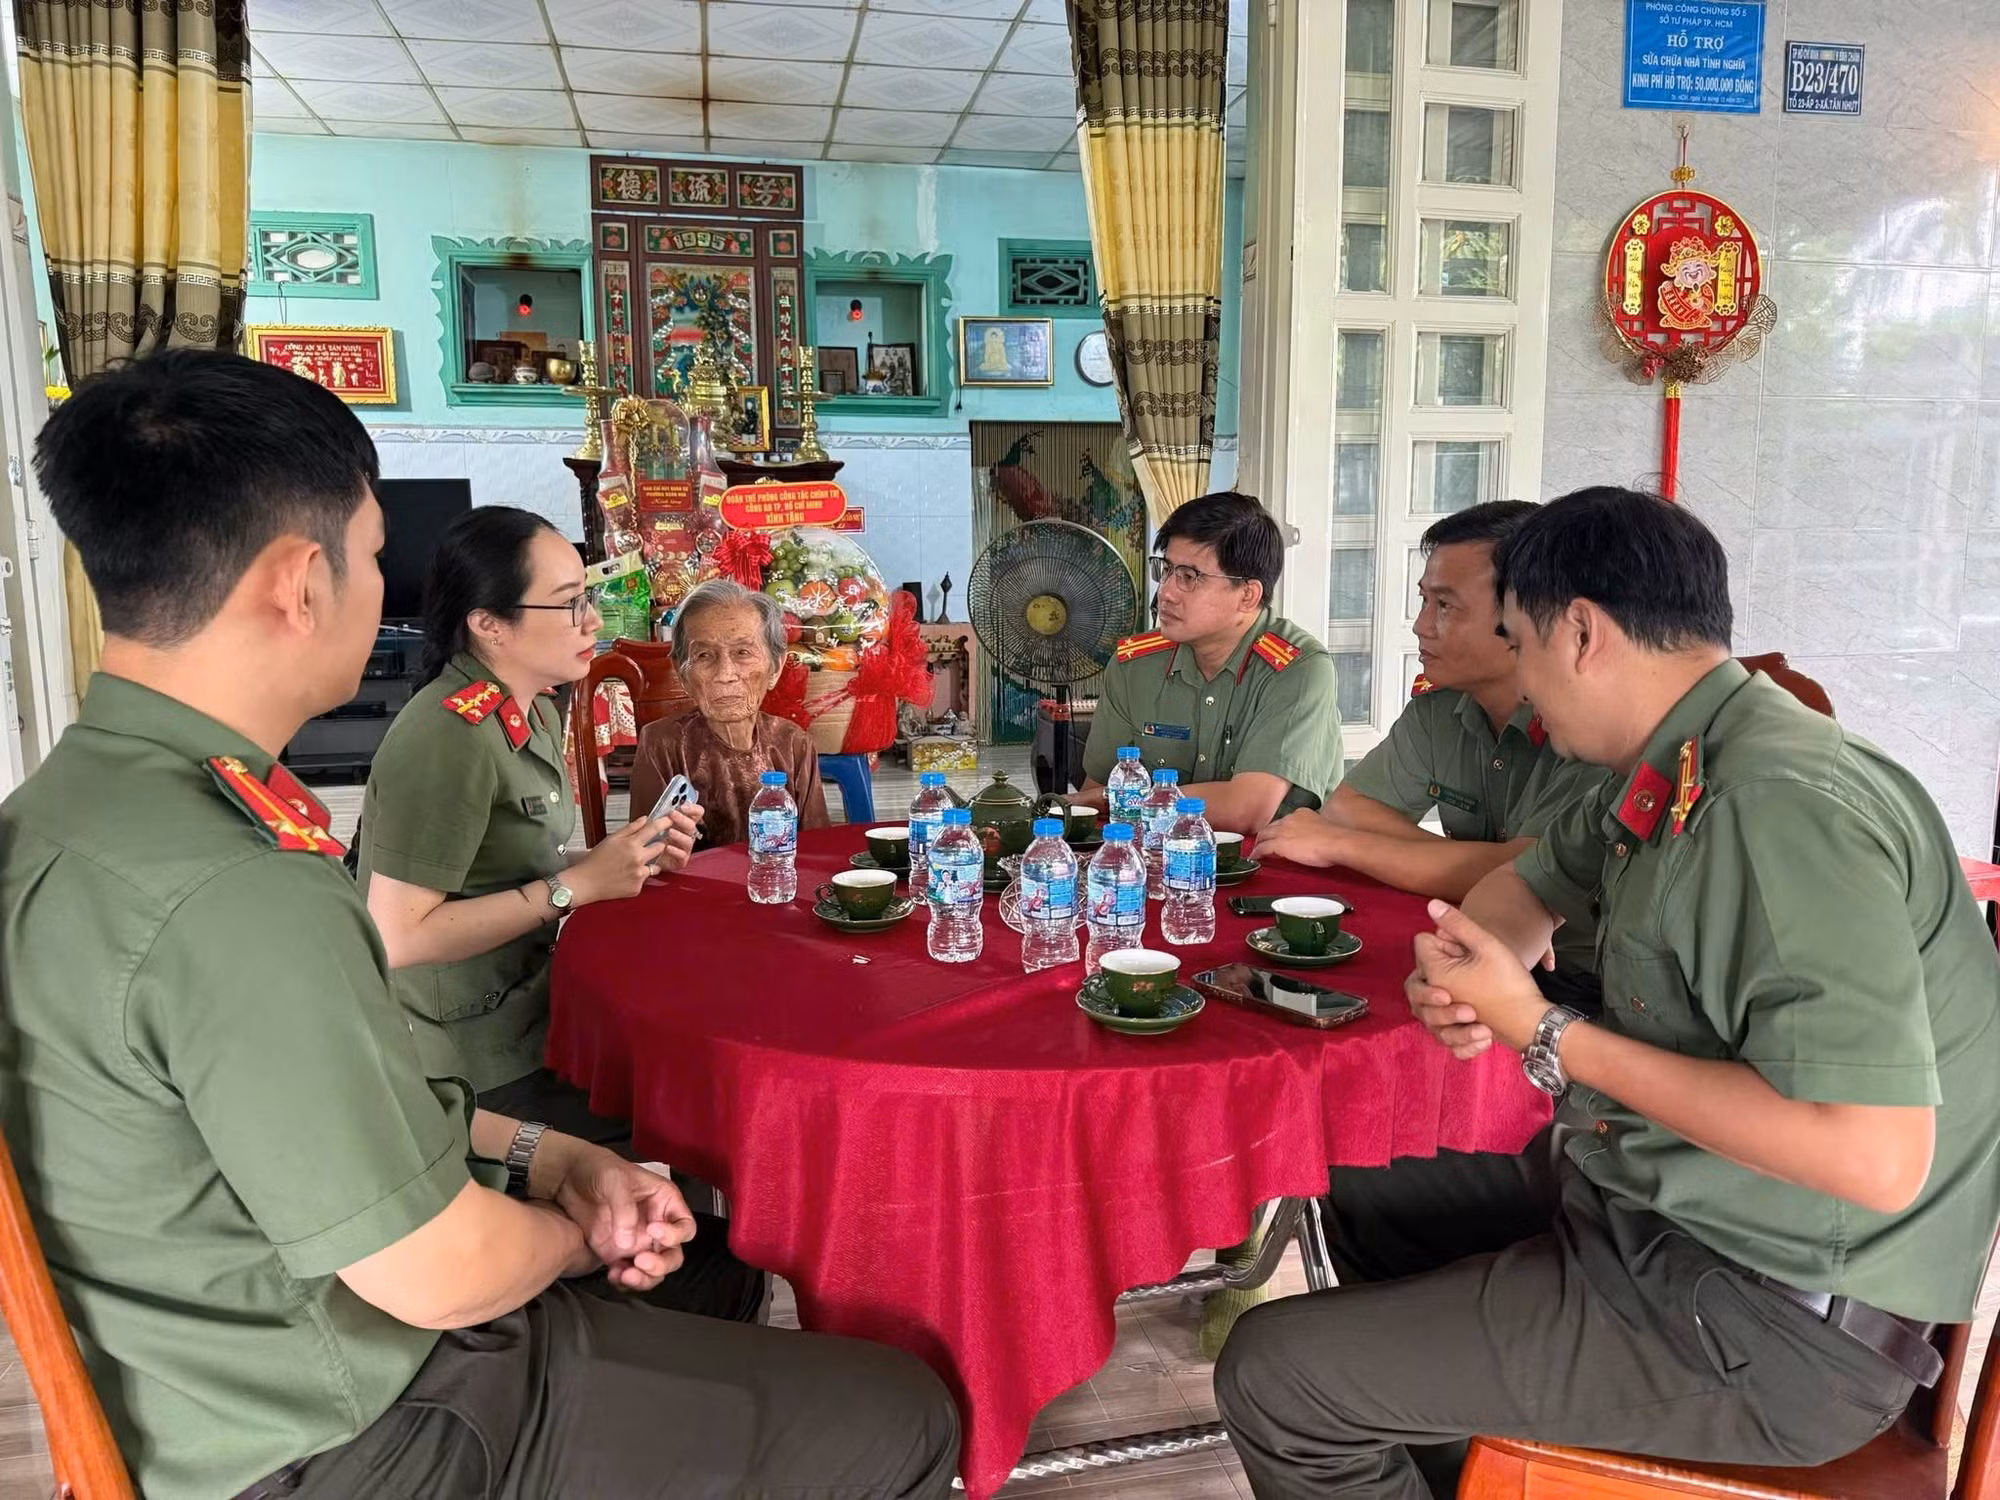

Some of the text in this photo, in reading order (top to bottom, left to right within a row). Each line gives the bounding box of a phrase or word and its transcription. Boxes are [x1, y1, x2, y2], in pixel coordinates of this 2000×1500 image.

[1675, 4, 1698, 14] CÔNG
[1682, 16, 1702, 26] PHÁP
[1715, 20, 1733, 28] HCM
[1667, 30, 1725, 53] HỖ TRỢ
[1684, 55, 1700, 68] NHÀ
[1723, 57, 1746, 70] NGHĨA
[1632, 73, 1650, 88] KINH
[1651, 71, 1664, 89] PHÍ
[1694, 76, 1733, 92] 50.000.000
[1790, 61, 1858, 95] B23/470
[673, 231, 726, 251] 1995
[766, 511, 804, 524] KÍNH TẶNG
